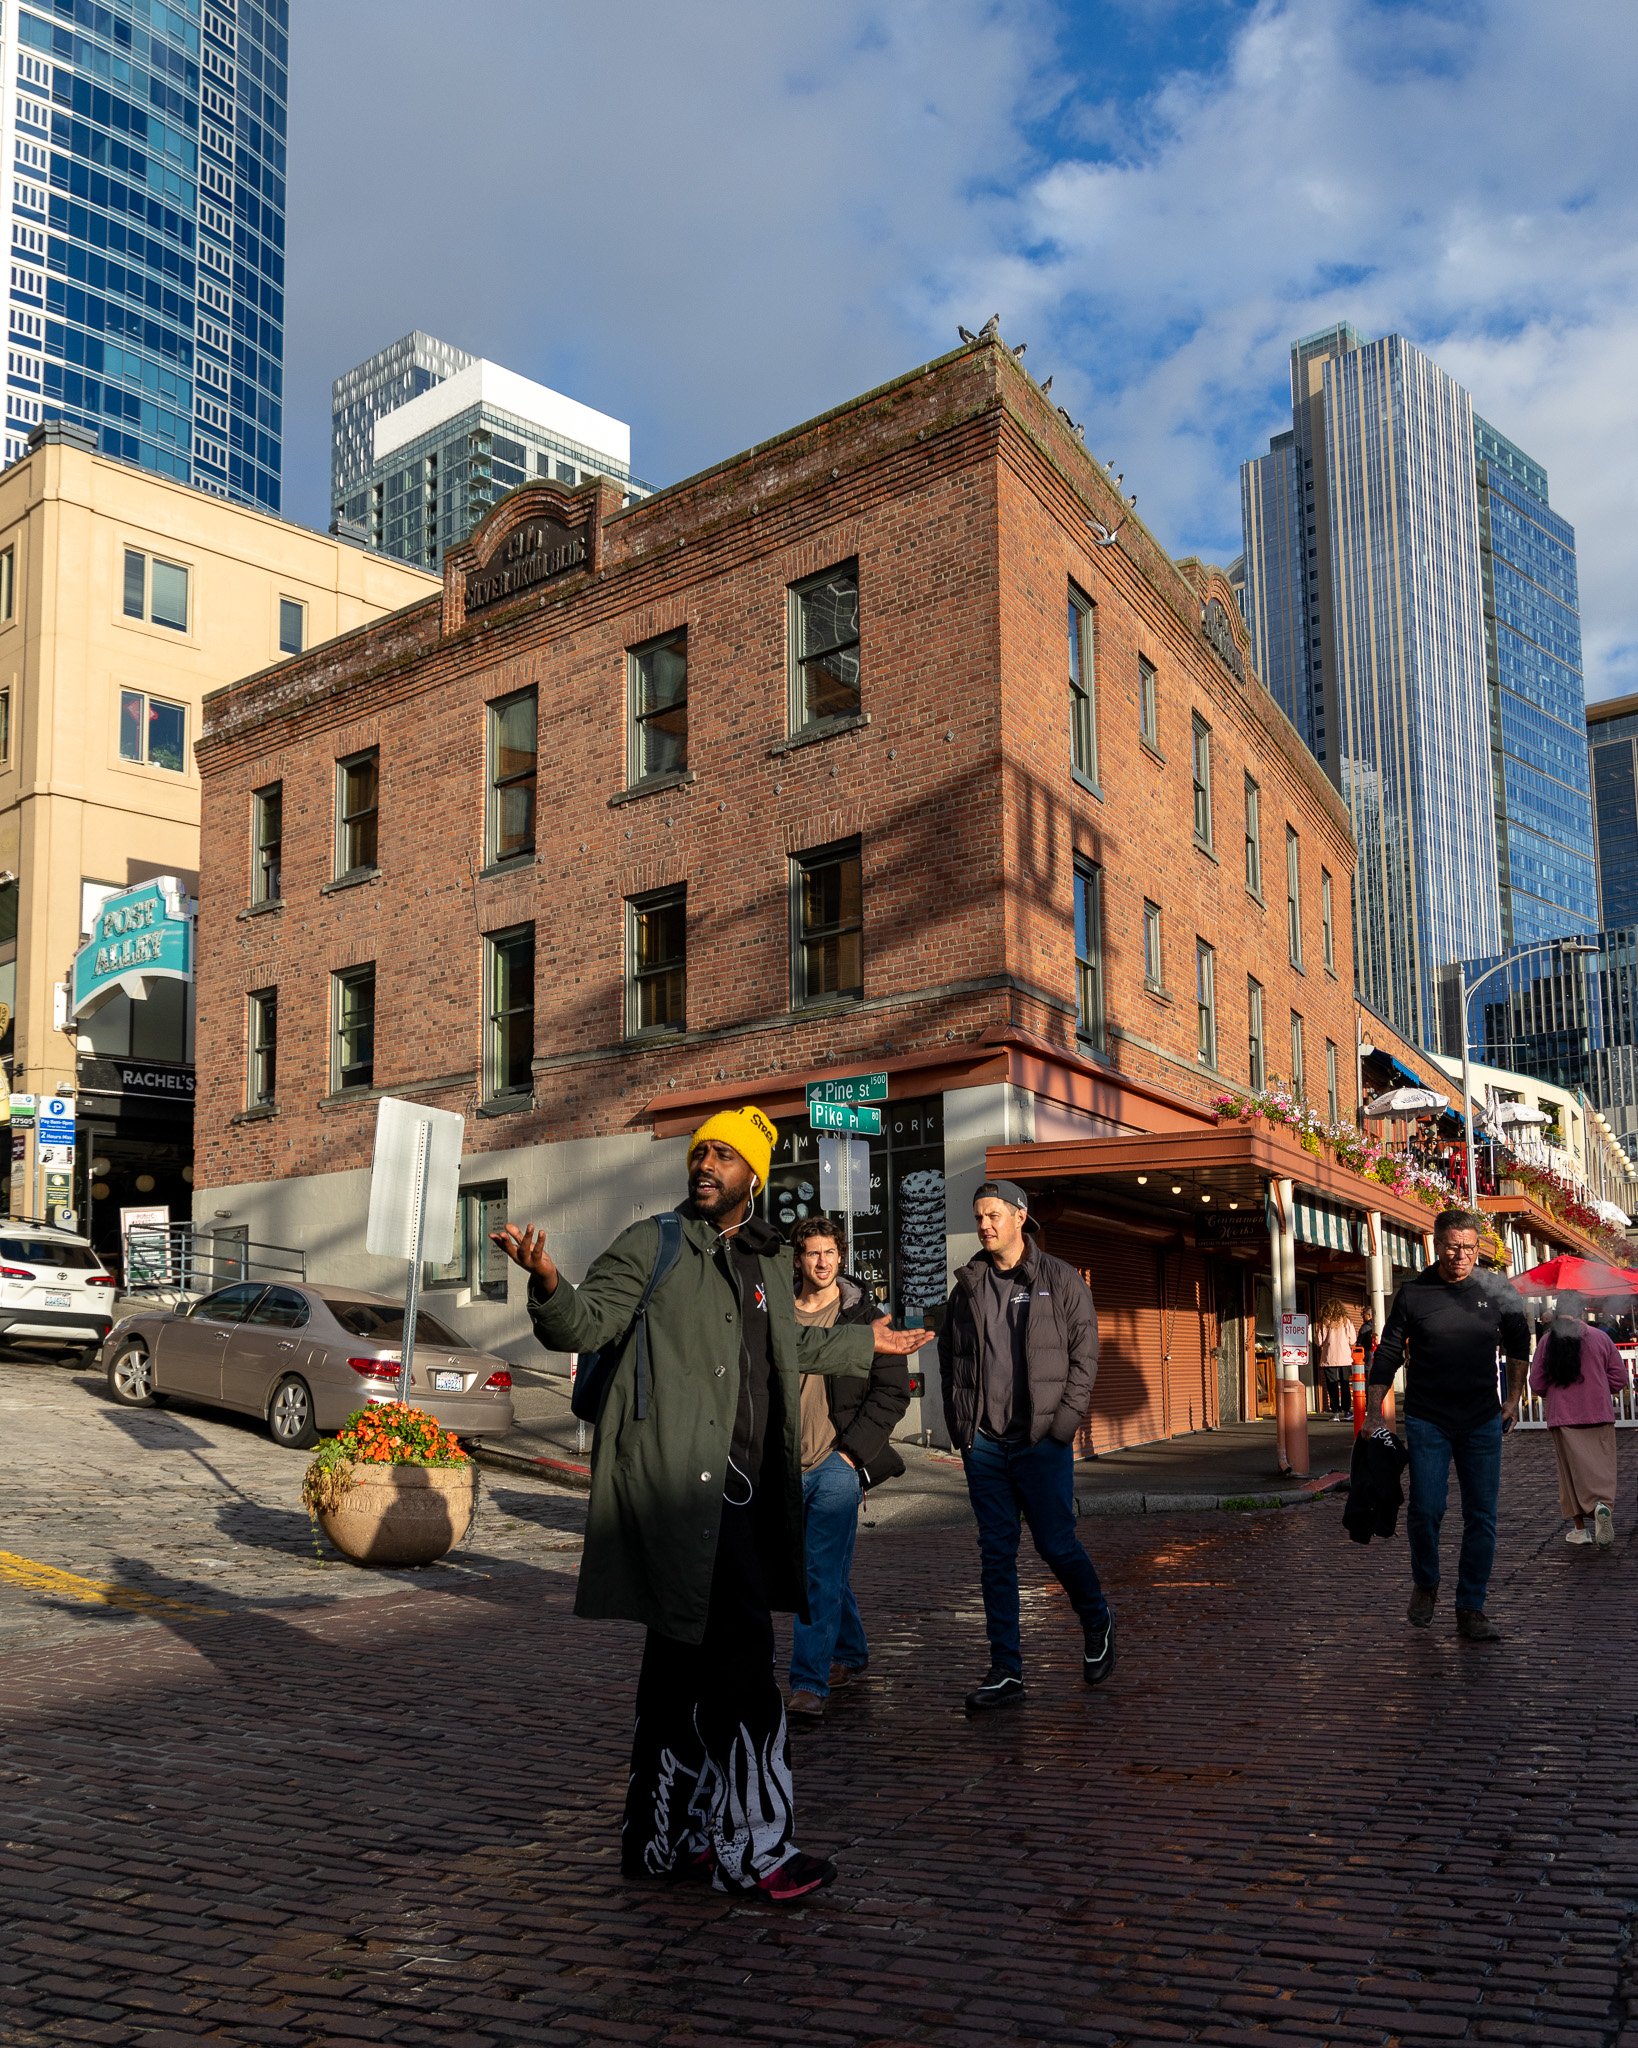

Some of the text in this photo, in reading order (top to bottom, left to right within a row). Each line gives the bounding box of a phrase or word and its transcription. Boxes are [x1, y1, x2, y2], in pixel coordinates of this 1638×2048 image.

[103, 897, 157, 938] POST
[94, 928, 166, 976] ALLEY
[122, 1070, 194, 1091] RACHEL'S
[825, 1074, 886, 1101] Pine St 1500
[815, 1104, 843, 1127] Pike
[849, 1114, 859, 1129] Pl
[40, 1131, 46, 1139] 2
[1283, 1315, 1291, 1323] NO
[1284, 1326, 1305, 1335] STOPS
